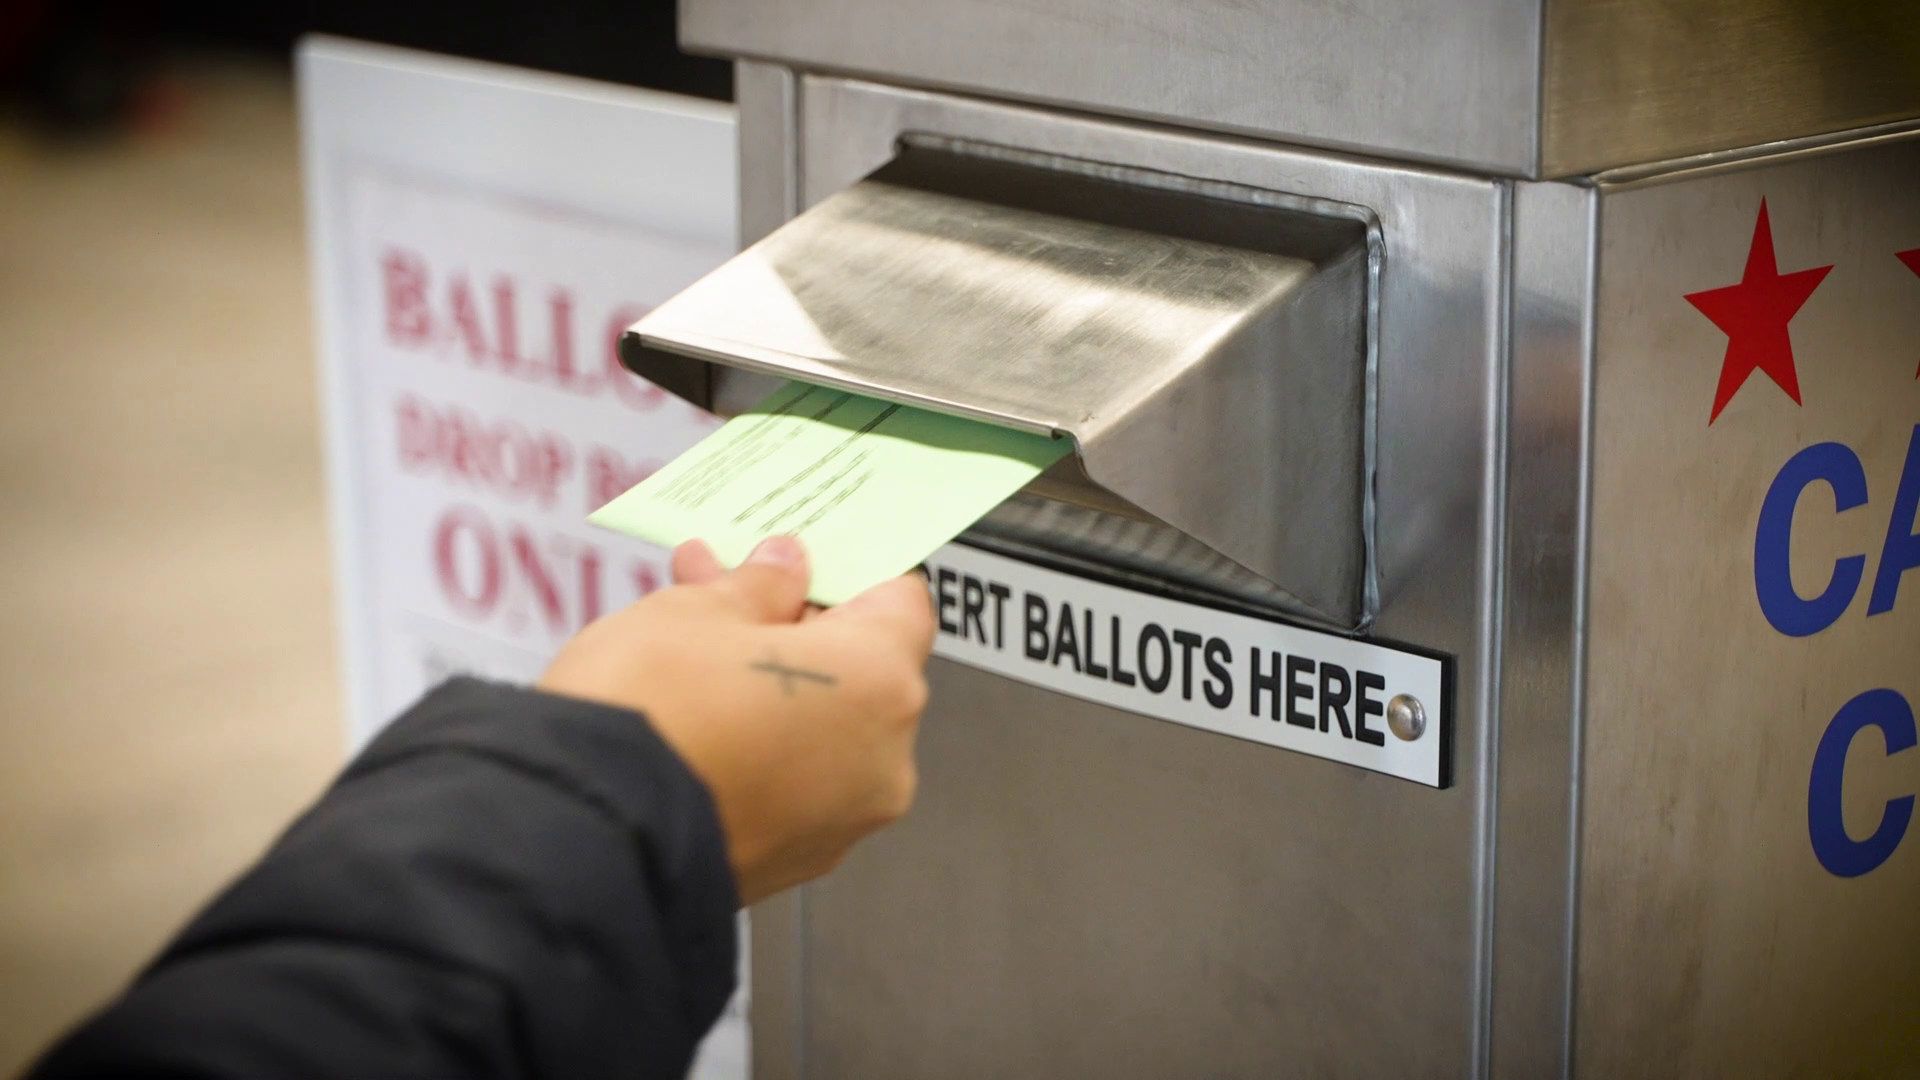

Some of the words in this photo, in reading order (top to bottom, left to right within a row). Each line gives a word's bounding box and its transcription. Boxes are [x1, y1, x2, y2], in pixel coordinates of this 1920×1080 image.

[380, 247, 708, 424] BALLO
[396, 393, 573, 505] DROP
[922, 563, 1010, 650] ERT
[1024, 592, 1233, 709] BALLOTS
[1250, 647, 1386, 747] HERE
[1808, 688, 1918, 878] C
